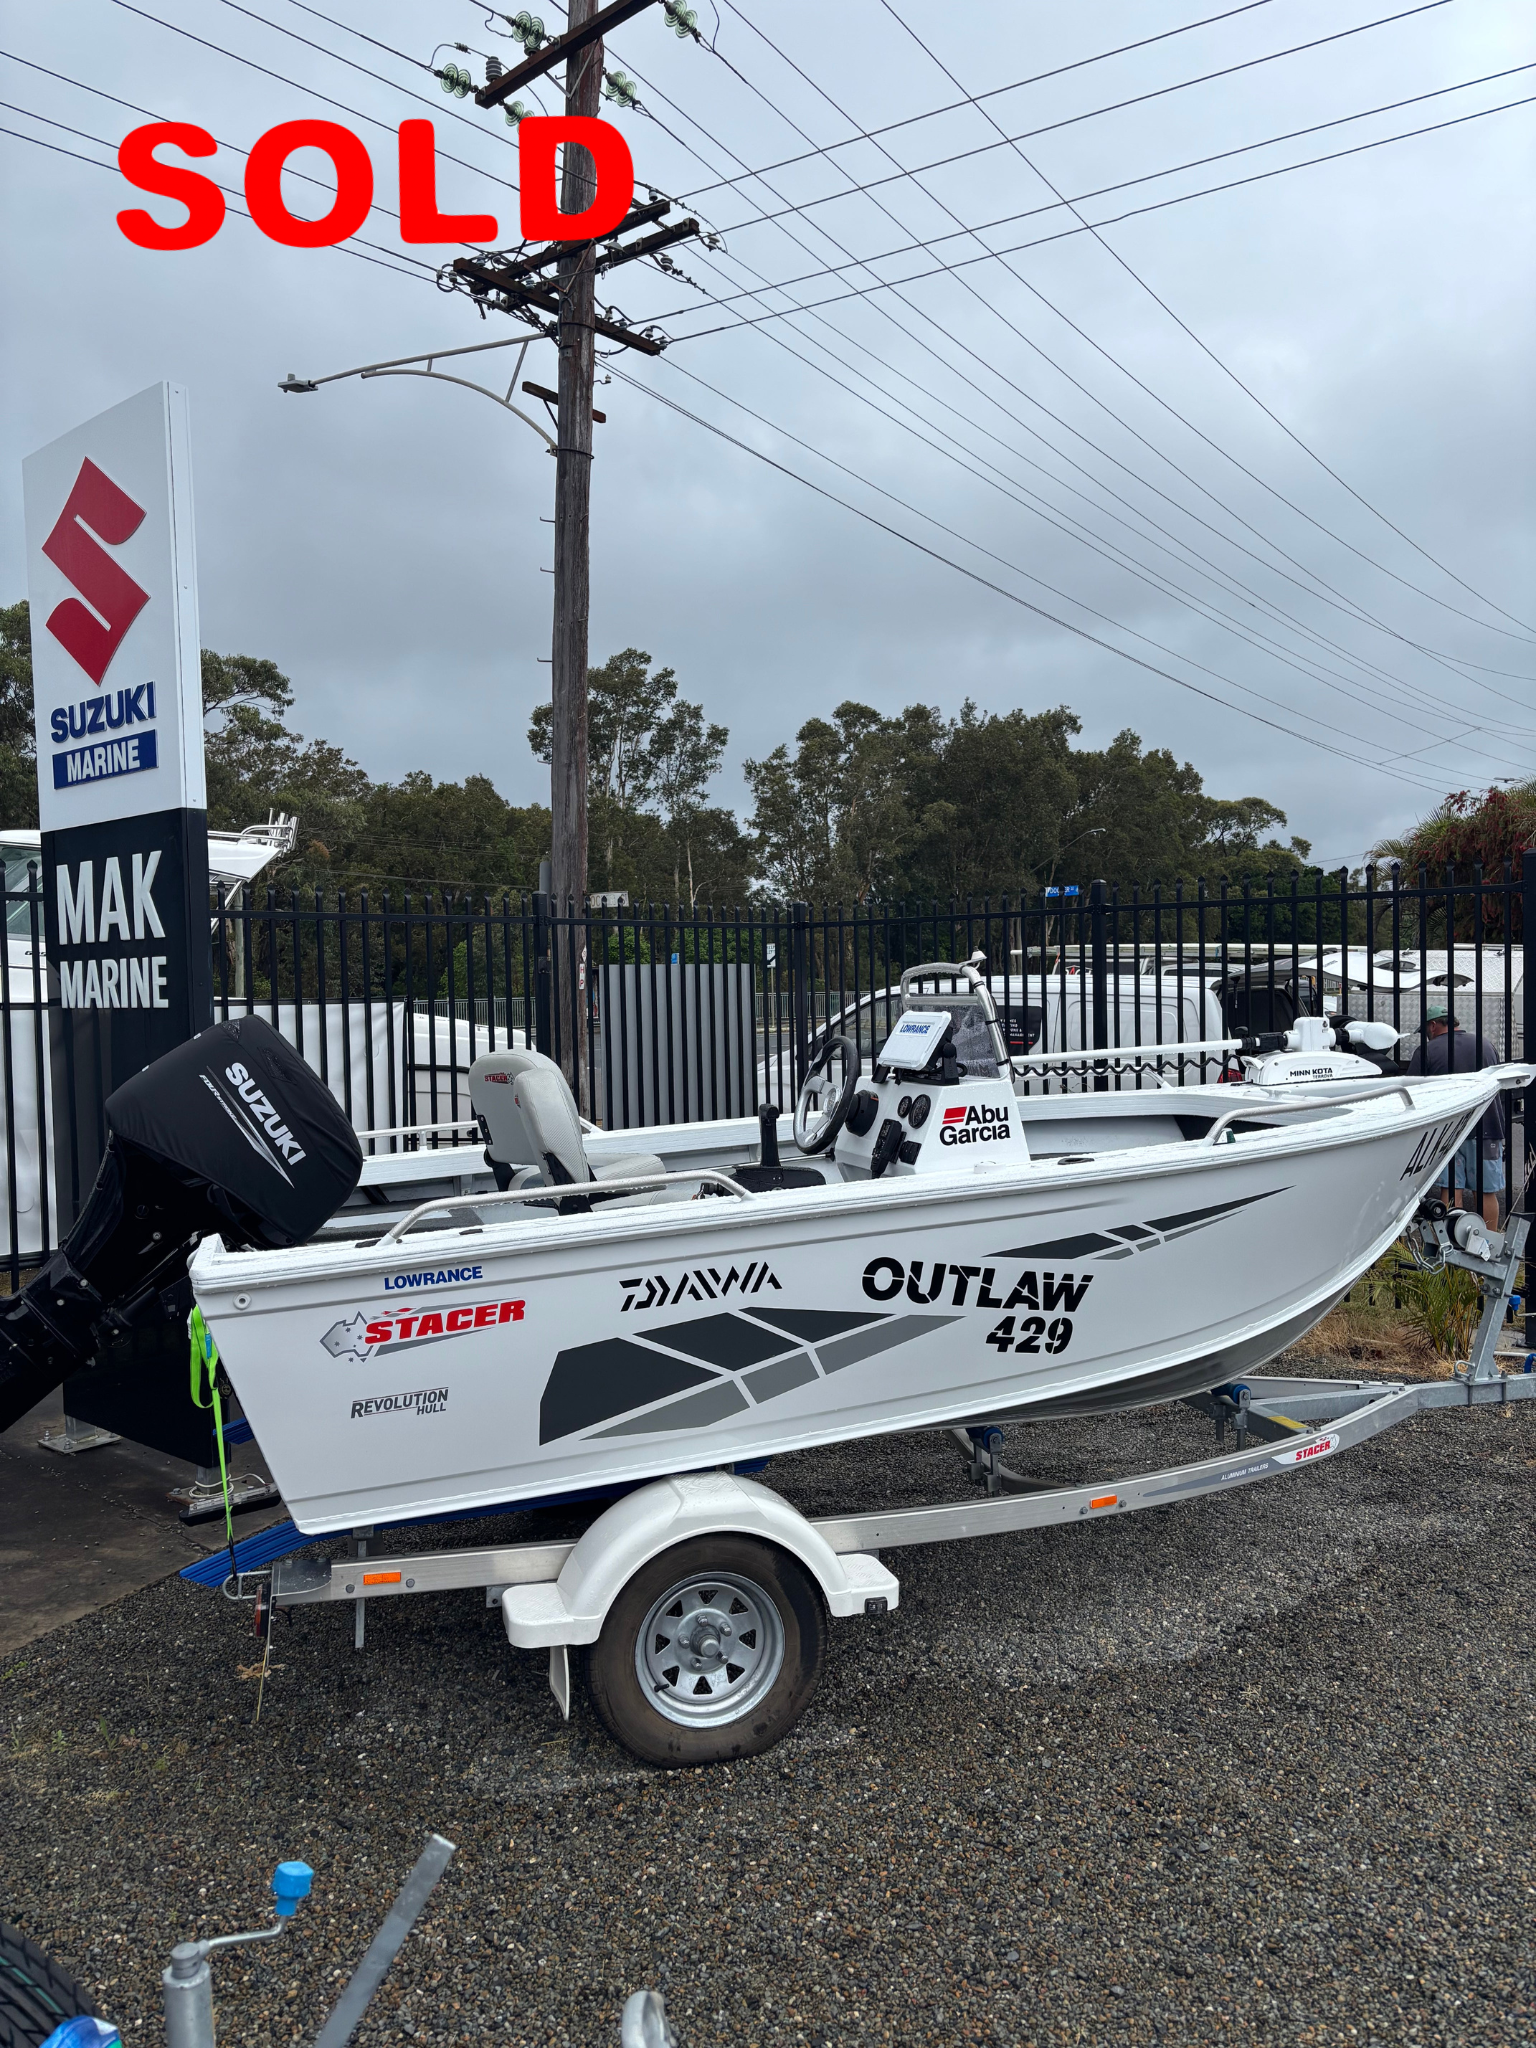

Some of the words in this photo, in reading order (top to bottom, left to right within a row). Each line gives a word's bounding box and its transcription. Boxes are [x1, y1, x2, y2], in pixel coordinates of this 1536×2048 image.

[50, 681, 156, 743] SUZUKI
[66, 738, 140, 783] MARINE
[56, 850, 166, 945] MAK
[60, 956, 169, 1009] MARINE
[900, 1024, 930, 1034] LOWRANCE
[1290, 1069, 1310, 1077] MINN
[1312, 1067, 1333, 1075] KOTA
[225, 1062, 307, 1165] SUZUKI
[965, 1104, 1009, 1126] Abu
[939, 1124, 1011, 1146] Garcia
[384, 1266, 483, 1290] LOWRANCE
[861, 1256, 1094, 1313] OUTLAW
[365, 1299, 526, 1345] STACER
[986, 1316, 1074, 1355] 429
[351, 1389, 449, 1418] REVOLUTION
[416, 1402, 446, 1415] HULL
[1295, 1440, 1331, 1461] STACER
[1248, 1462, 1269, 1474] TRAILERS
